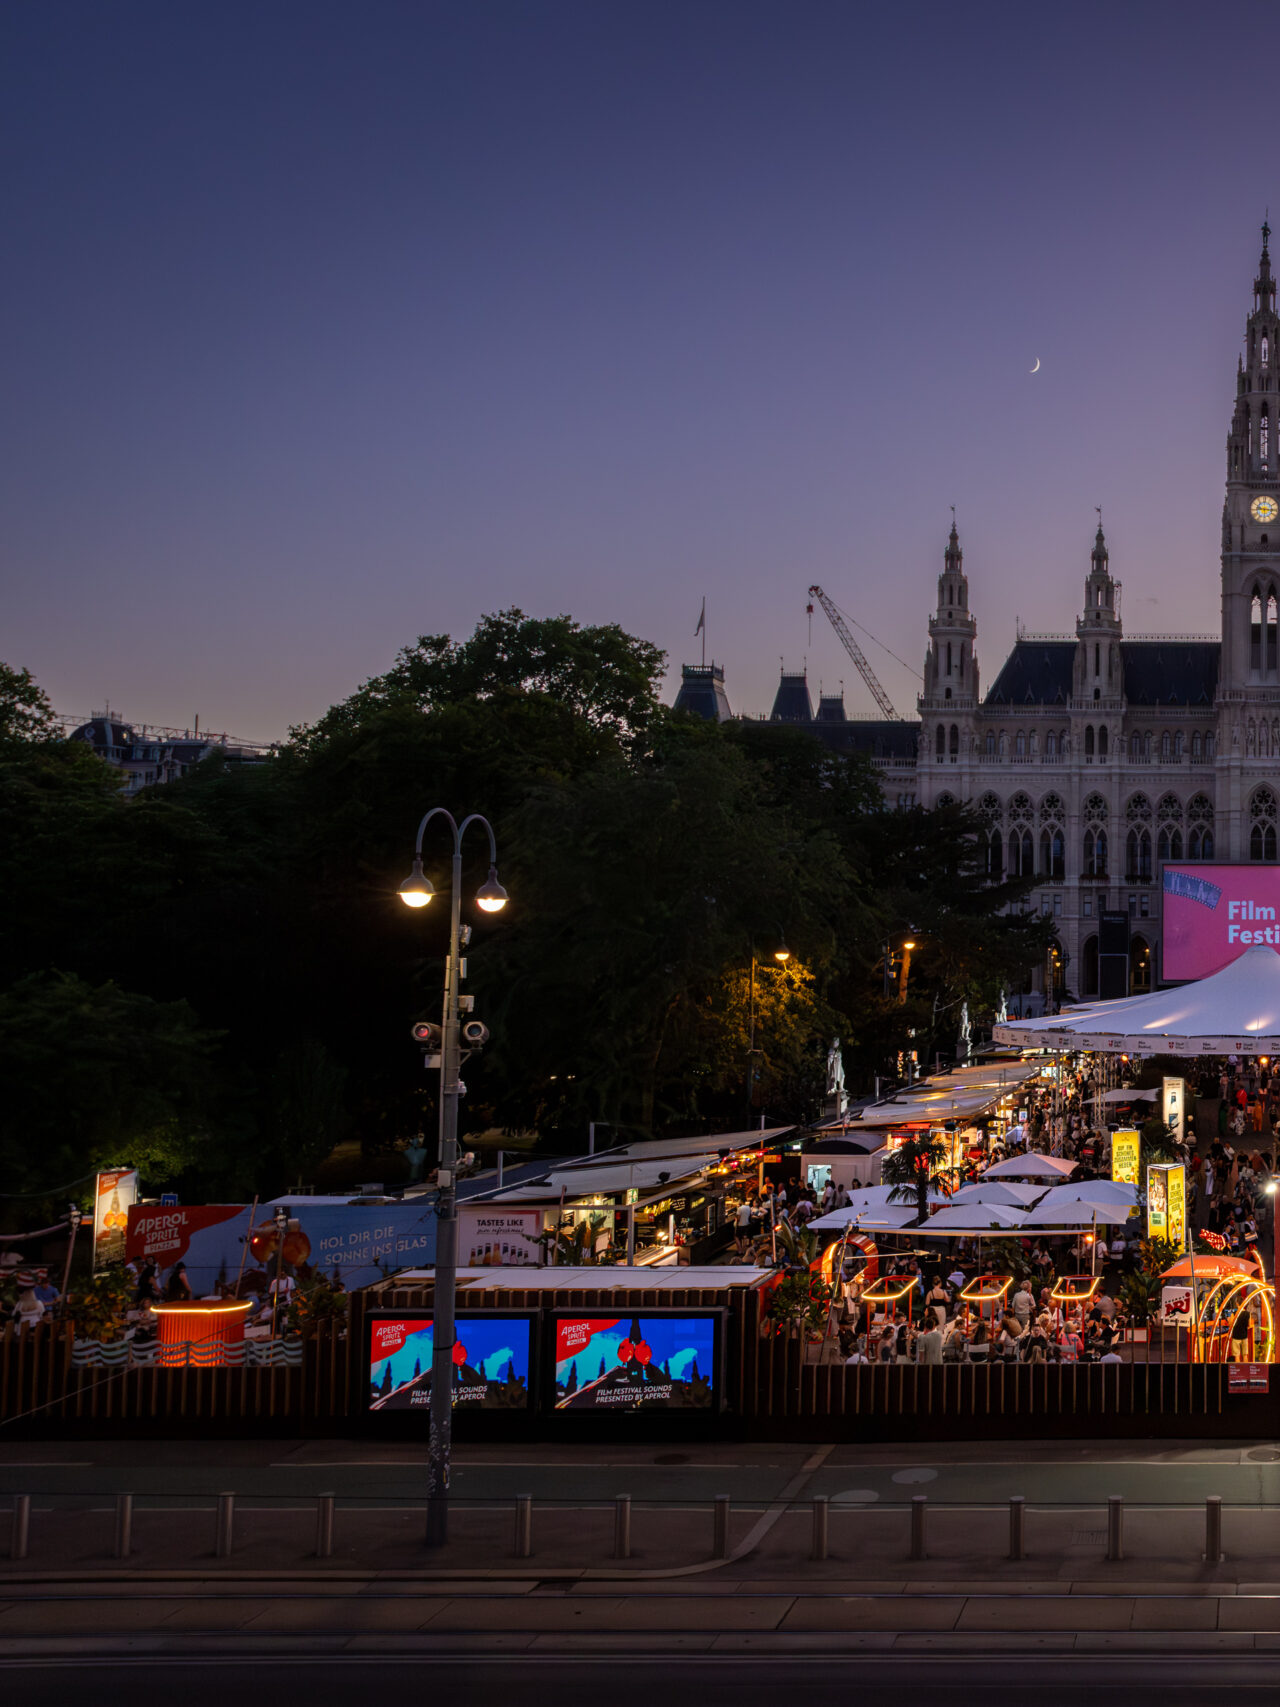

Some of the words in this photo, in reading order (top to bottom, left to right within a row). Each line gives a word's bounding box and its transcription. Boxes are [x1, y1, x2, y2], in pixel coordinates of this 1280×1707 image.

[1228, 900, 1275, 921] Film
[134, 1211, 189, 1237] APEROL
[477, 1219, 505, 1227] TASTES
[507, 1219, 524, 1227] LIKE
[145, 1227, 179, 1244] SPRITZ
[320, 1236, 344, 1250] HOL
[348, 1230, 370, 1245] DIR
[374, 1226, 394, 1241] DIE
[325, 1247, 369, 1265] SONNE
[371, 1242, 392, 1258] INS
[396, 1236, 428, 1253] GLAS
[1164, 1292, 1190, 1317] NRJ
[376, 1323, 406, 1337] APEROL
[561, 1322, 591, 1336] APEROL
[567, 1331, 586, 1341] SPRITZ
[382, 1332, 401, 1342] SPRITZ
[412, 1389, 427, 1397] FILM
[459, 1385, 488, 1393] SOUNDS
[595, 1395, 634, 1404] PRESENTED
[644, 1392, 671, 1400] APEROL
[597, 1389, 613, 1397] FILM
[613, 1386, 643, 1396] FESTIVAL
[643, 1385, 673, 1393] SOUNDS
[410, 1396, 431, 1405] PRESE
[459, 1392, 486, 1401] APEROL
